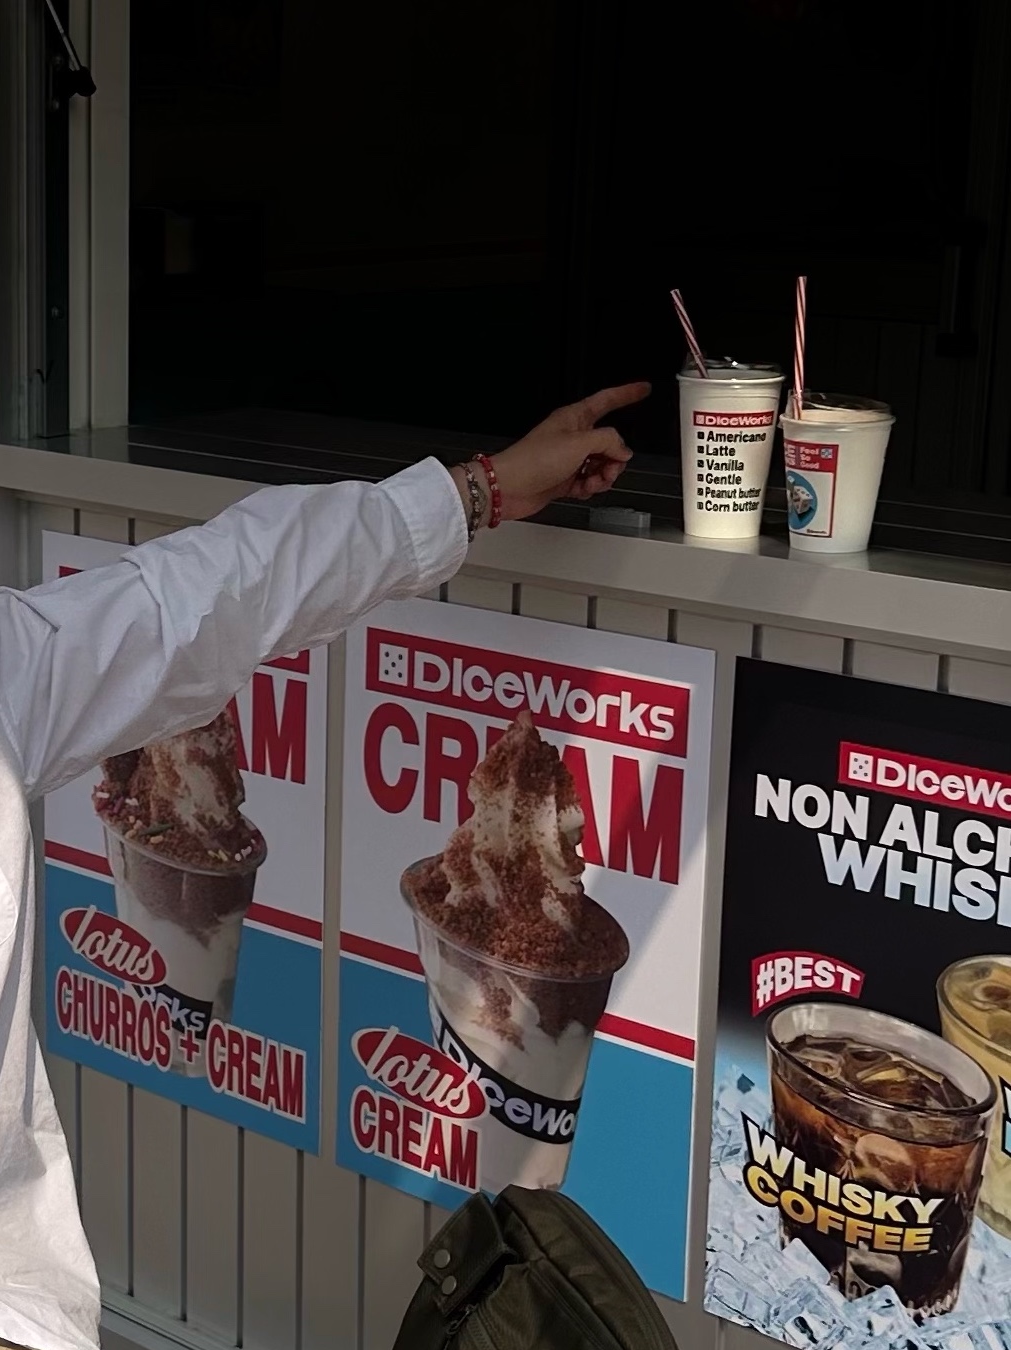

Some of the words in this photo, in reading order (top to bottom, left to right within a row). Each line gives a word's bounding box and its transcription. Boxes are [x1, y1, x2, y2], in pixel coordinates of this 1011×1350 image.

[705, 445, 736, 456] Latte
[706, 431, 766, 443] Americano
[705, 473, 742, 485] Gentle
[706, 459, 744, 471] Vanilla
[705, 487, 737, 499] Peanut
[738, 487, 761, 499] butter
[705, 500, 730, 512] Corn
[732, 501, 759, 512] butter
[363, 702, 684, 885] CRAM
[755, 773, 870, 841] NON
[756, 957, 861, 1008] #BEST
[56, 967, 173, 1070] CHURROS
[207, 1022, 304, 1120] CREAM
[353, 1088, 479, 1190] CREAM
[745, 1120, 944, 1224] WHISKY
[746, 1165, 934, 1252] COFFEE
